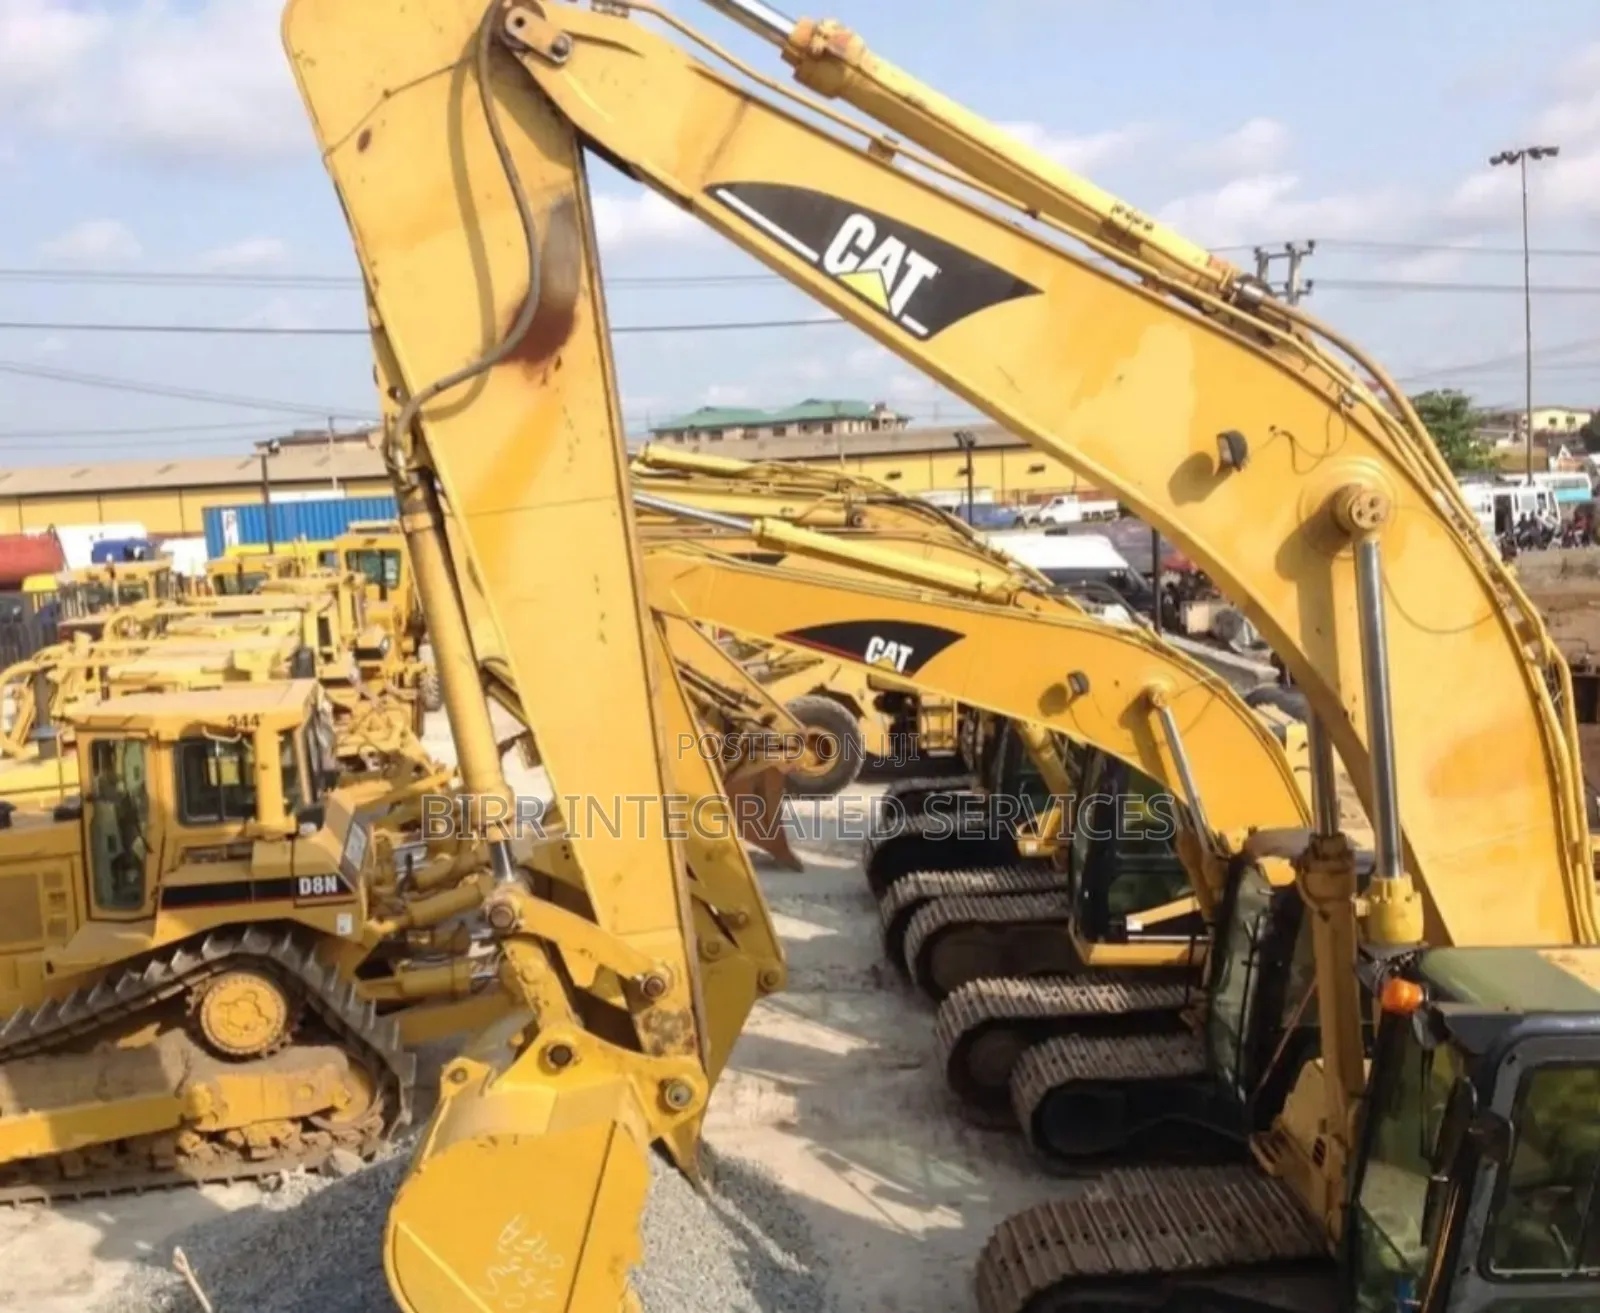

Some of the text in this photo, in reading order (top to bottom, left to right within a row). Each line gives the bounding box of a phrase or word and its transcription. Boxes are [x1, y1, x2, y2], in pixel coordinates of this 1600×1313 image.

[824, 213, 940, 318] CAT
[864, 636, 914, 673] CAT
[299, 875, 338, 897] D8N
